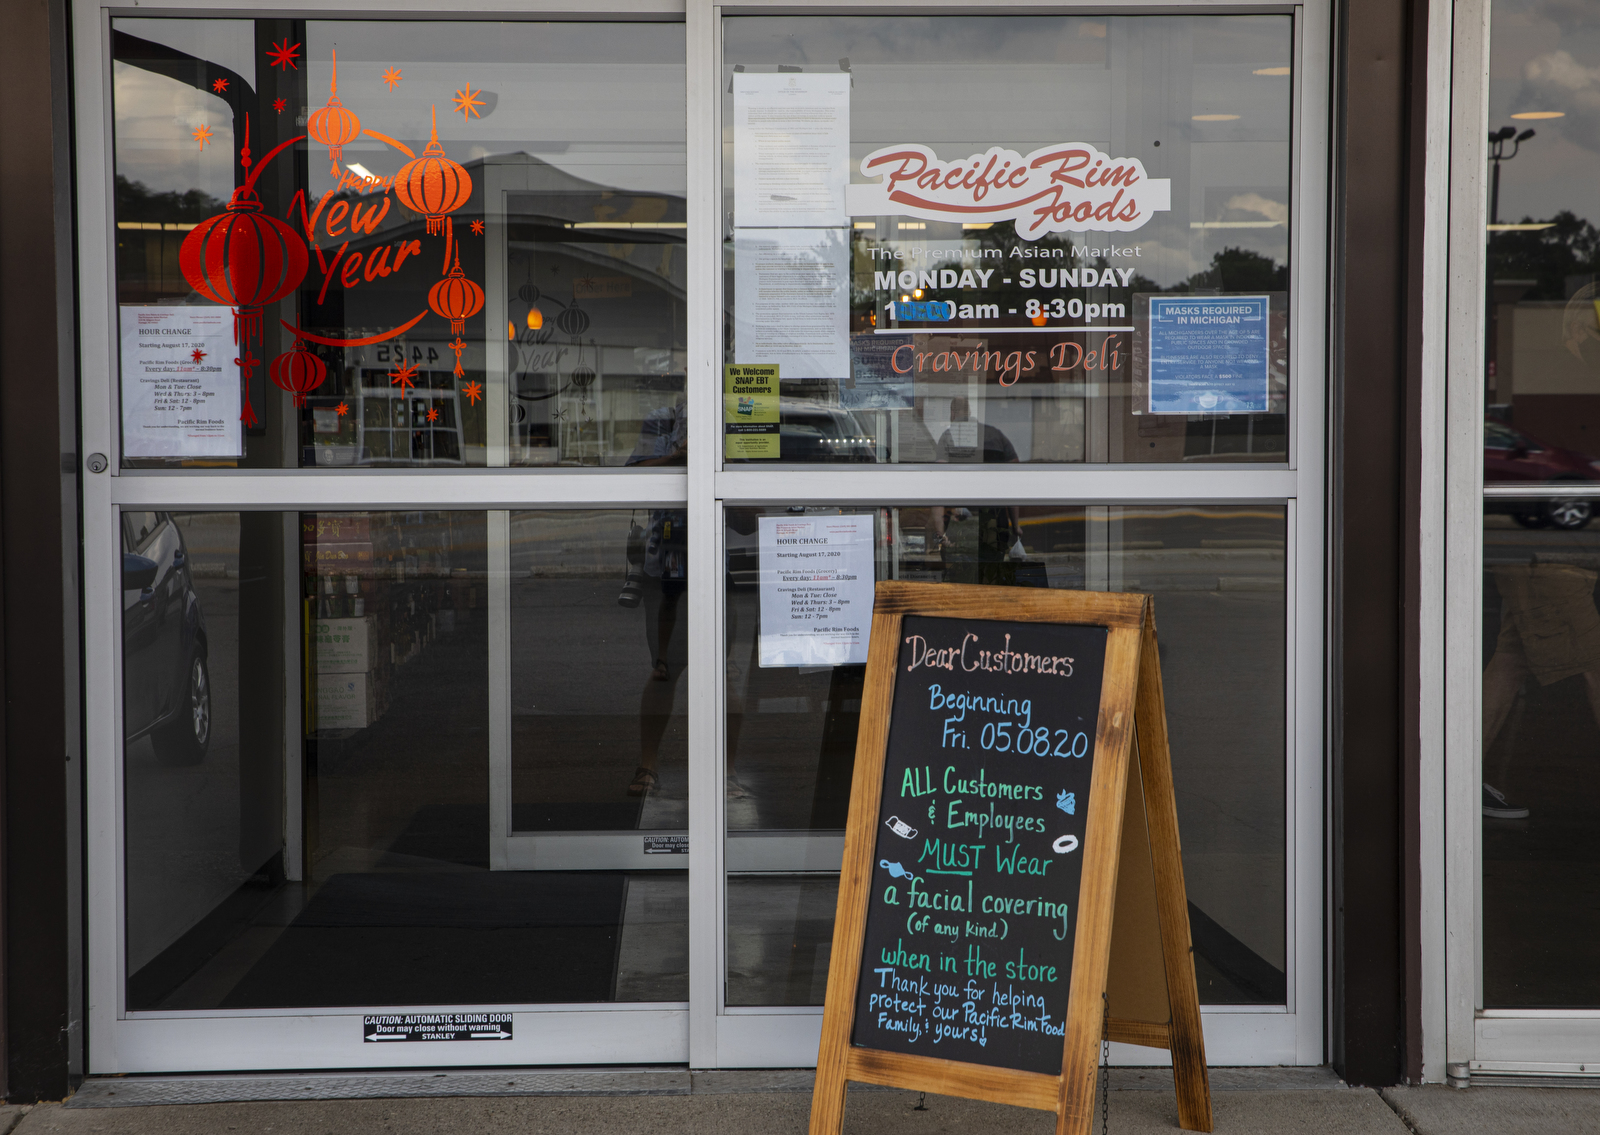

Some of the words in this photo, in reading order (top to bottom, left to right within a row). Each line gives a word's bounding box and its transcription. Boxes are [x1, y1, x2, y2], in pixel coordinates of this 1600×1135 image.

[337, 169, 395, 195] Happy
[867, 151, 1029, 202] Pacific
[1030, 149, 1140, 189] Rim
[286, 188, 391, 242] New
[1029, 186, 1141, 232] Foods
[866, 247, 905, 260] The
[911, 246, 1003, 259] Premium
[1009, 245, 1064, 258] Asian
[1070, 244, 1142, 258] Market
[315, 239, 421, 306] Year
[874, 268, 995, 291] MONDAY
[1019, 267, 1135, 289] SUNDAY
[1025, 297, 1126, 323] 8:30pm
[1165, 307, 1200, 315] MASKS
[1202, 306, 1253, 315] REQUIRED
[1177, 316, 1188, 324] IN
[1190, 315, 1241, 324] MICHIGAN
[729, 367, 741, 376] We
[742, 367, 775, 376] Welcome
[890, 341, 1038, 387] Cravings
[1050, 334, 1122, 371] Deli
[732, 385, 772, 394] Customers
[735, 376, 754, 385] SNAP
[756, 376, 769, 385] EBT
[798, 537, 829, 545] CHANGE
[782, 574, 799, 582] Every
[905, 635, 961, 672] Dear
[960, 632, 1075, 677] Customers
[928, 683, 1032, 729] Beginning
[942, 717, 970, 749] Fri.
[980, 721, 1088, 758] 05.08.20
[900, 765, 938, 798] ALL
[943, 765, 1044, 801] Customers
[947, 798, 1046, 844] Employees
[917, 838, 986, 870] MUST
[996, 843, 1053, 877] Wear
[883, 885, 900, 905] a
[906, 876, 974, 913] facial
[981, 896, 1069, 941] covering
[906, 911, 931, 935] (of
[933, 922, 959, 943] any
[881, 937, 932, 973] when
[939, 951, 958, 973] in
[963, 943, 997, 979] the
[1005, 947, 1058, 983] store
[873, 967, 931, 996] Thank
[933, 982, 960, 1005] you
[963, 979, 986, 1000] for
[992, 981, 1046, 1016] helping
[364, 1016, 403, 1025] CAUTION:
[404, 1014, 455, 1024] AUTOMATIC
[455, 1013, 488, 1023] SLIDING
[489, 1013, 512, 1023] DOOR
[376, 1025, 396, 1033] Door
[396, 1025, 413, 1034] may
[414, 1024, 436, 1032] close
[437, 1023, 468, 1031] without
[468, 1023, 501, 1033] warning
[869, 992, 927, 1016] protect
[932, 1005, 960, 1020] our
[961, 1000, 1010, 1028] Pacific
[1009, 1012, 1039, 1032] Rim
[1035, 1015, 1066, 1037] Food
[421, 1032, 456, 1040] STANLEY
